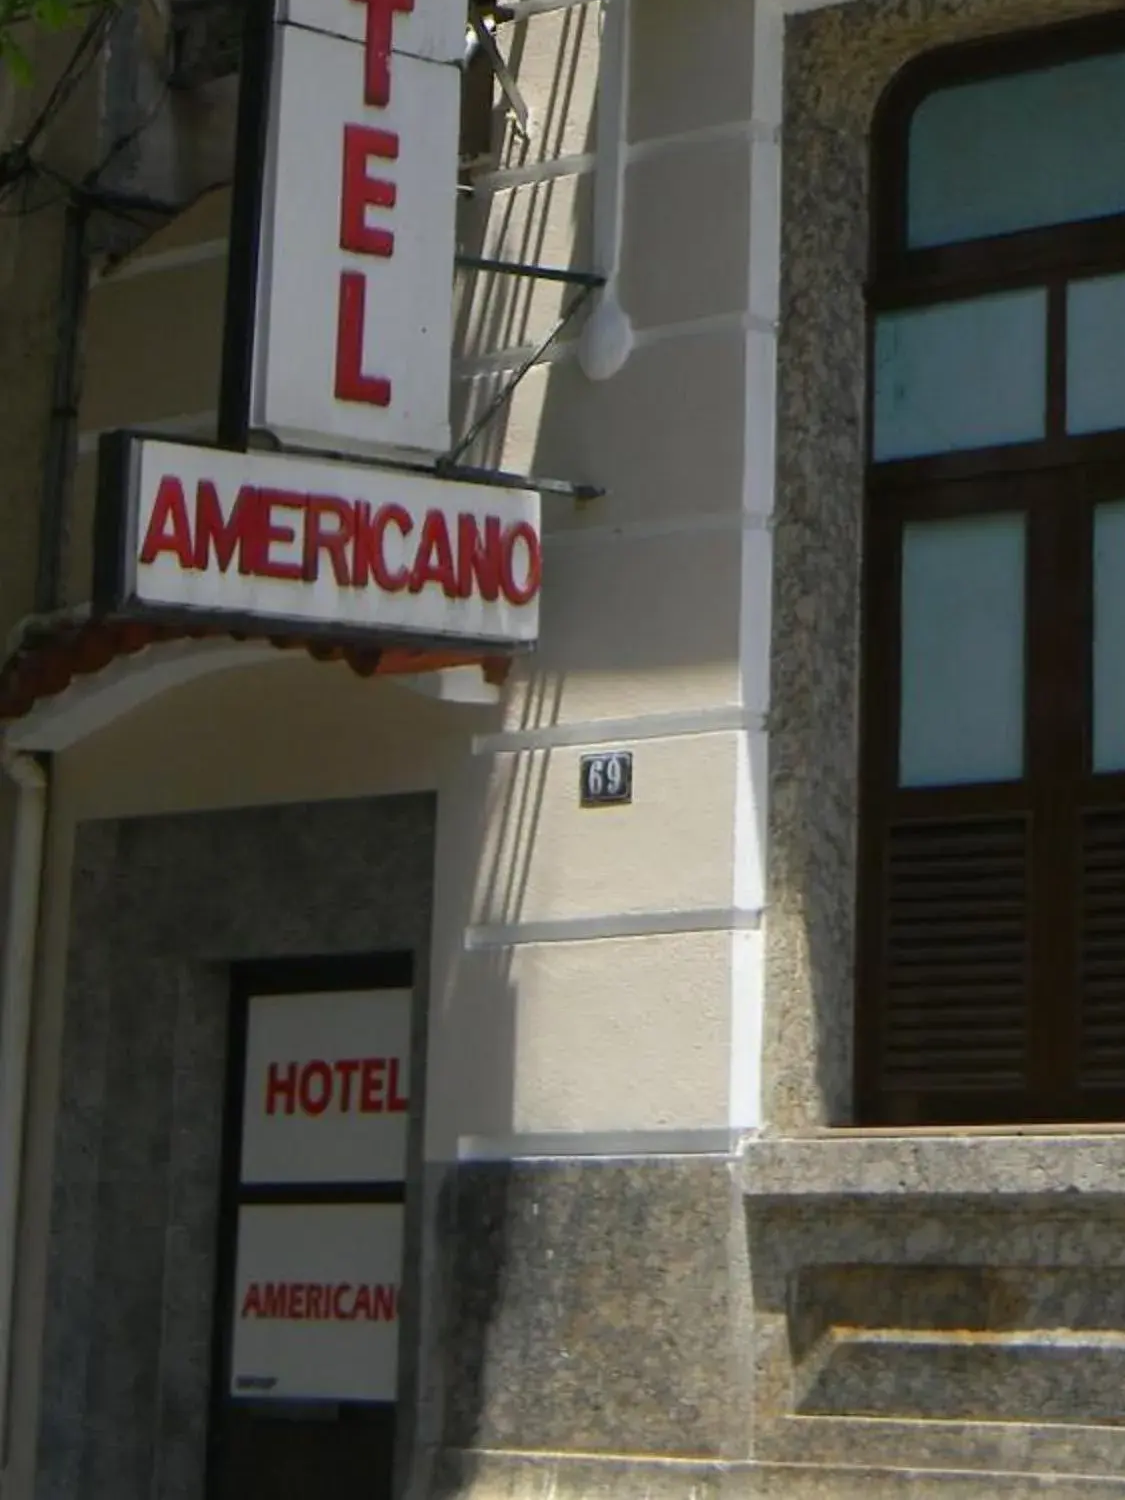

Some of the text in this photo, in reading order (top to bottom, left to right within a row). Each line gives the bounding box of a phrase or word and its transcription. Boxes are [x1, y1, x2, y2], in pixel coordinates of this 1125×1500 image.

[139, 474, 542, 606] AMERICANO
[588, 755, 621, 795] 69
[265, 1057, 409, 1116] HOTEL
[242, 1282, 401, 1322] AMERICAN
